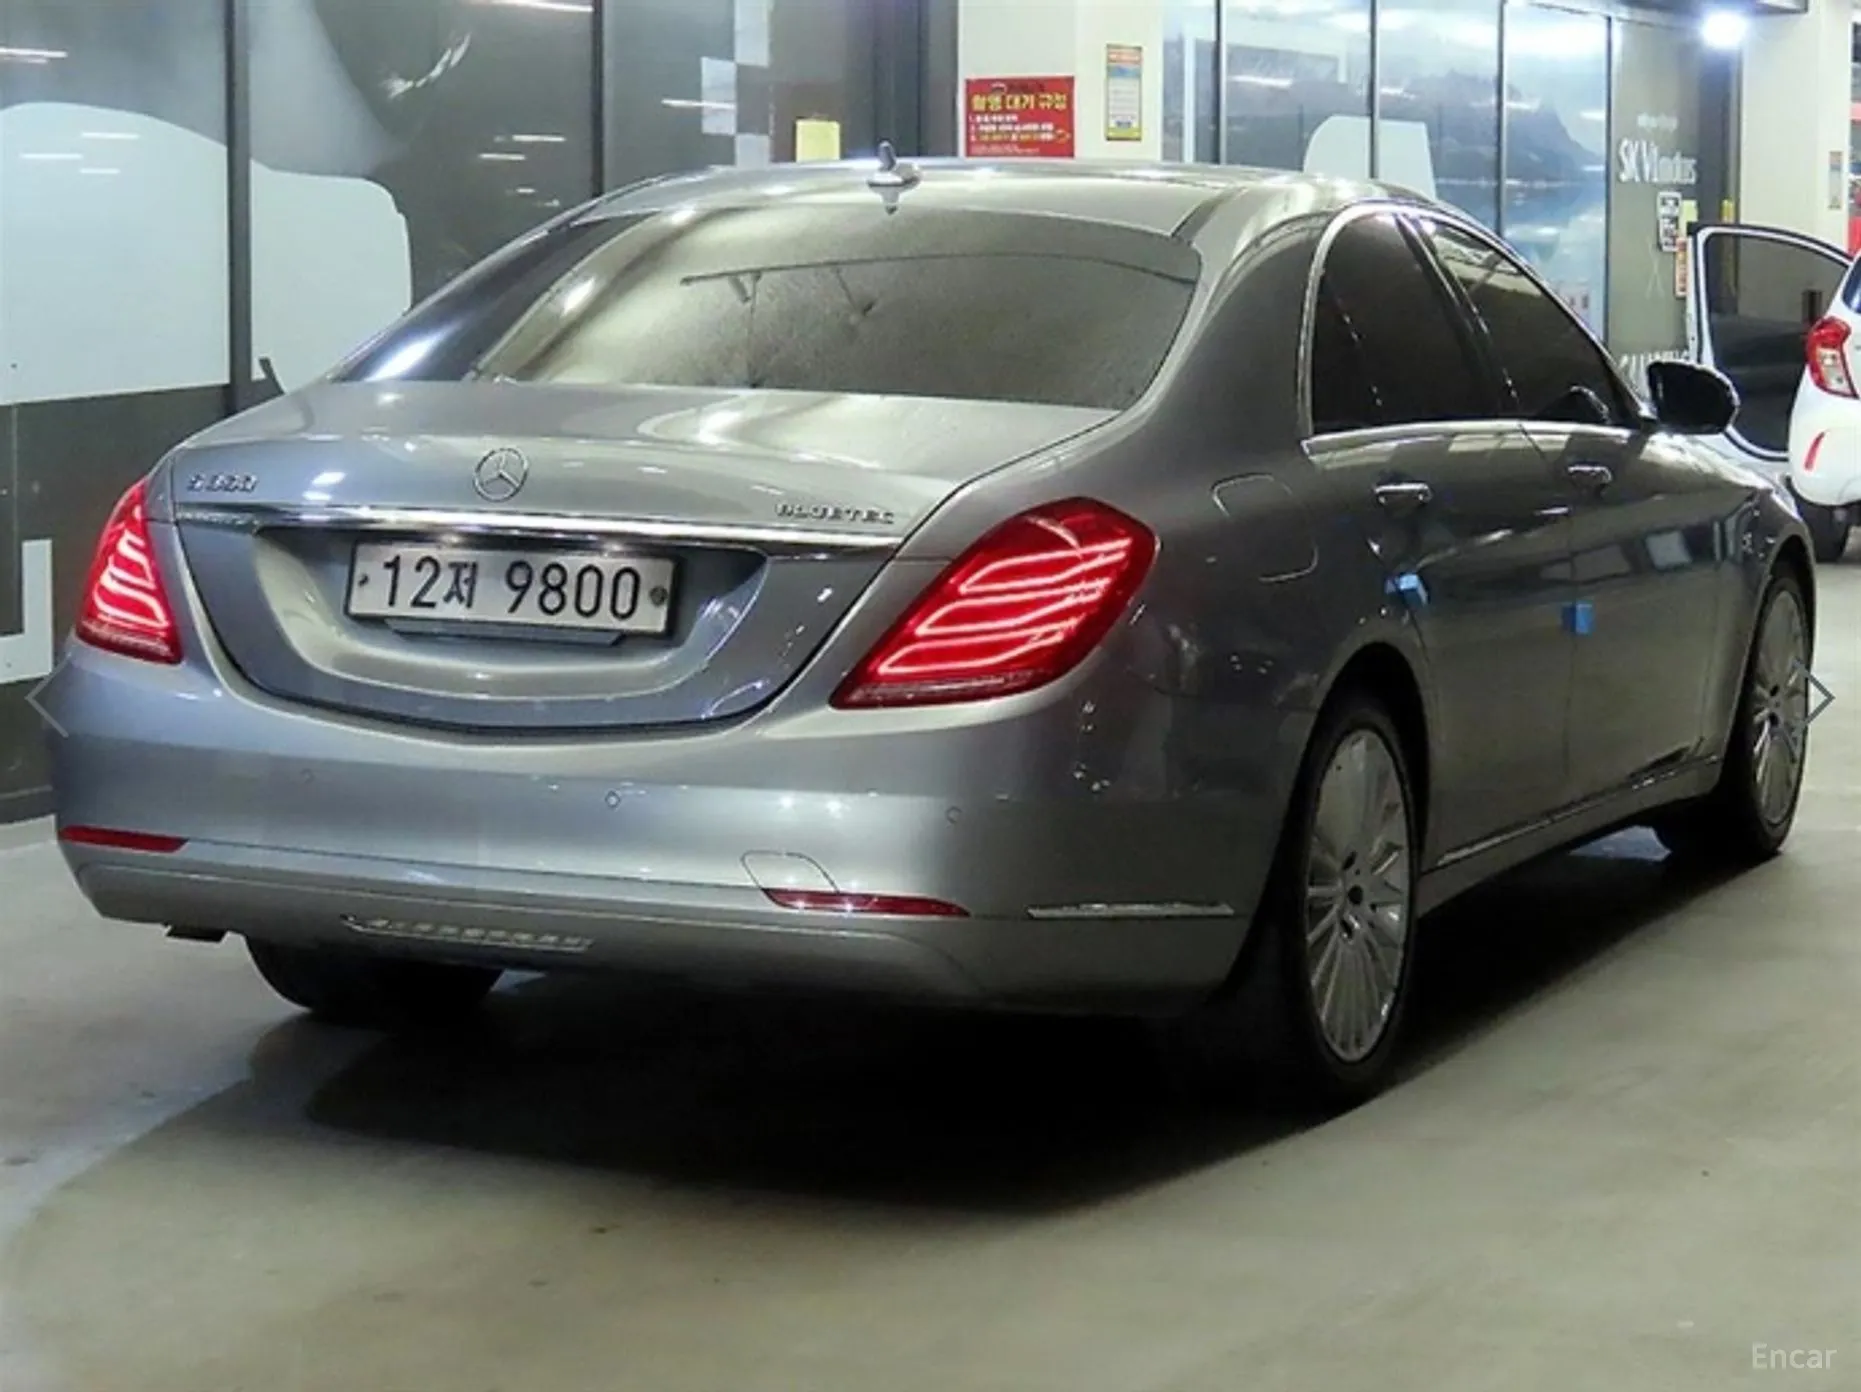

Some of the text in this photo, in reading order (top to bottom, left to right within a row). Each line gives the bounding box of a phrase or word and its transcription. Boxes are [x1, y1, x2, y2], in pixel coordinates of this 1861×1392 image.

[1005, 93, 1035, 110] 대기
[382, 555, 641, 621] 12저 9800
